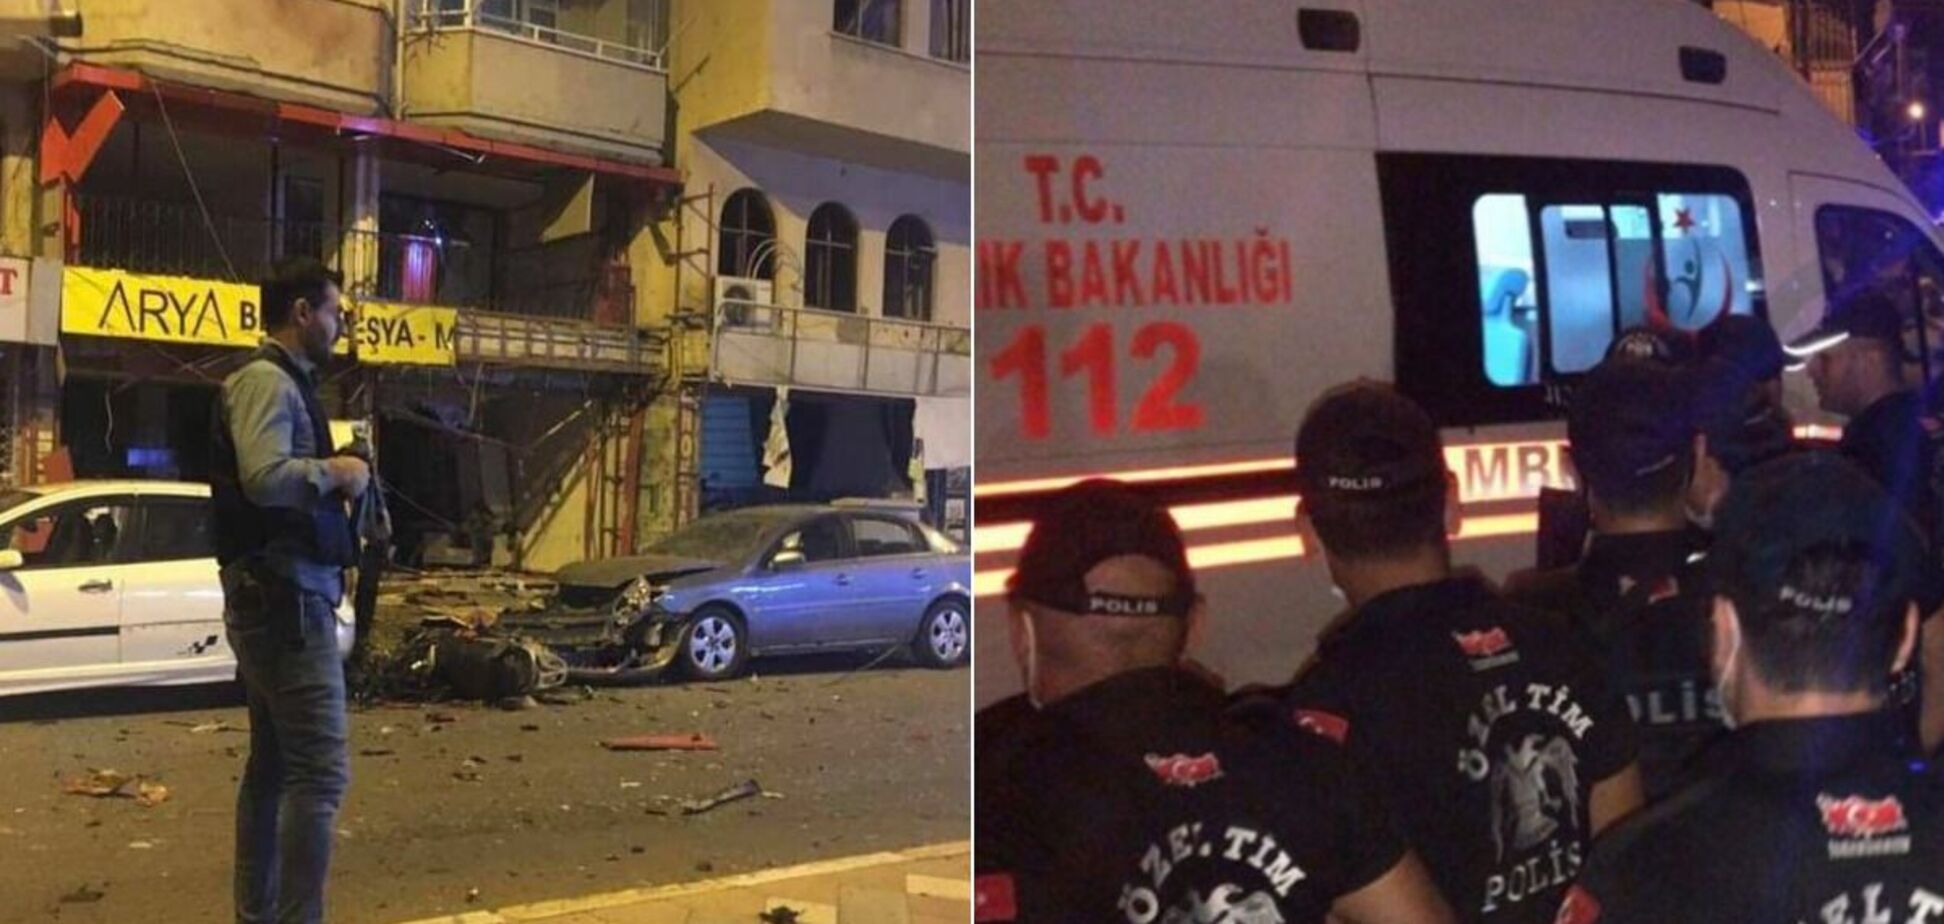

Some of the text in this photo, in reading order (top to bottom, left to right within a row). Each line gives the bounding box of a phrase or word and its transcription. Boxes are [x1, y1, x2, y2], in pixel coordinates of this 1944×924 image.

[1024, 155, 1125, 223] T.C.
[1045, 226, 1293, 308] BAKANLIĞI
[98, 279, 228, 340] ARYA
[988, 321, 1208, 440] 112
